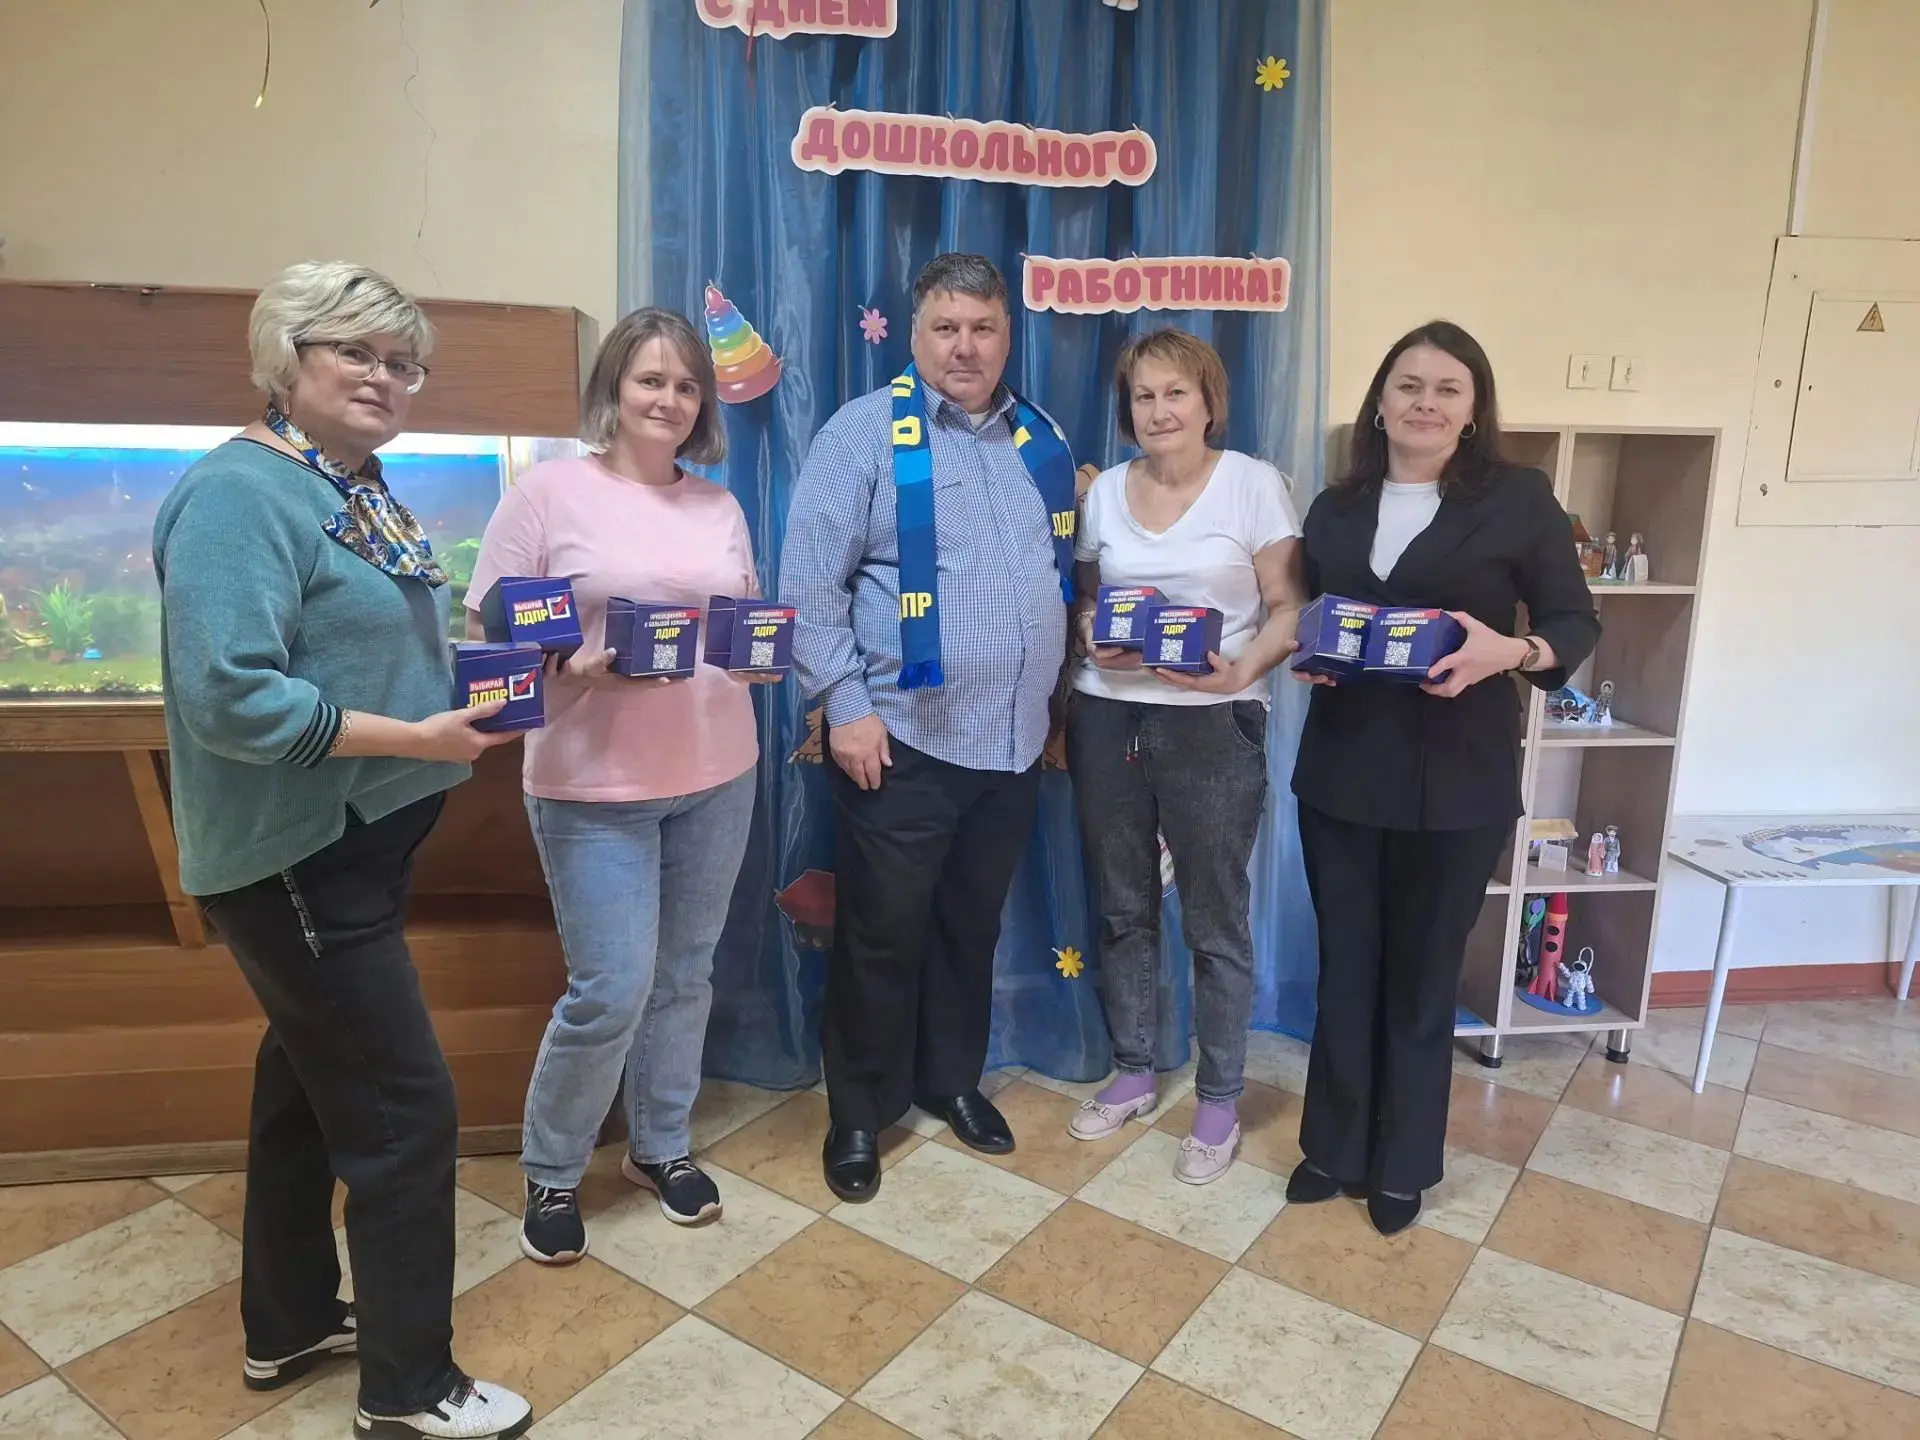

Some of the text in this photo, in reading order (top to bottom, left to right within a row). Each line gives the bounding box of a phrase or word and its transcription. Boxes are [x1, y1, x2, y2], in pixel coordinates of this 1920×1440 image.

[801, 118, 1146, 178] ДОШКОЛЬНОГО
[1032, 265, 1282, 303] РАБОТНИКА!
[514, 599, 544, 611] ВЫБИРАЙ
[899, 592, 932, 621] ПР
[1112, 602, 1135, 614] ЛДПР
[514, 608, 548, 626] ЛДПР
[1339, 617, 1365, 629] ЛДПР
[653, 627, 680, 640] ЛДПР
[752, 625, 777, 637] ЛДПР
[1161, 624, 1186, 636] ЛДПР
[1388, 626, 1416, 637] ЛДПР
[470, 677, 505, 691] ВЫБИРАЙ
